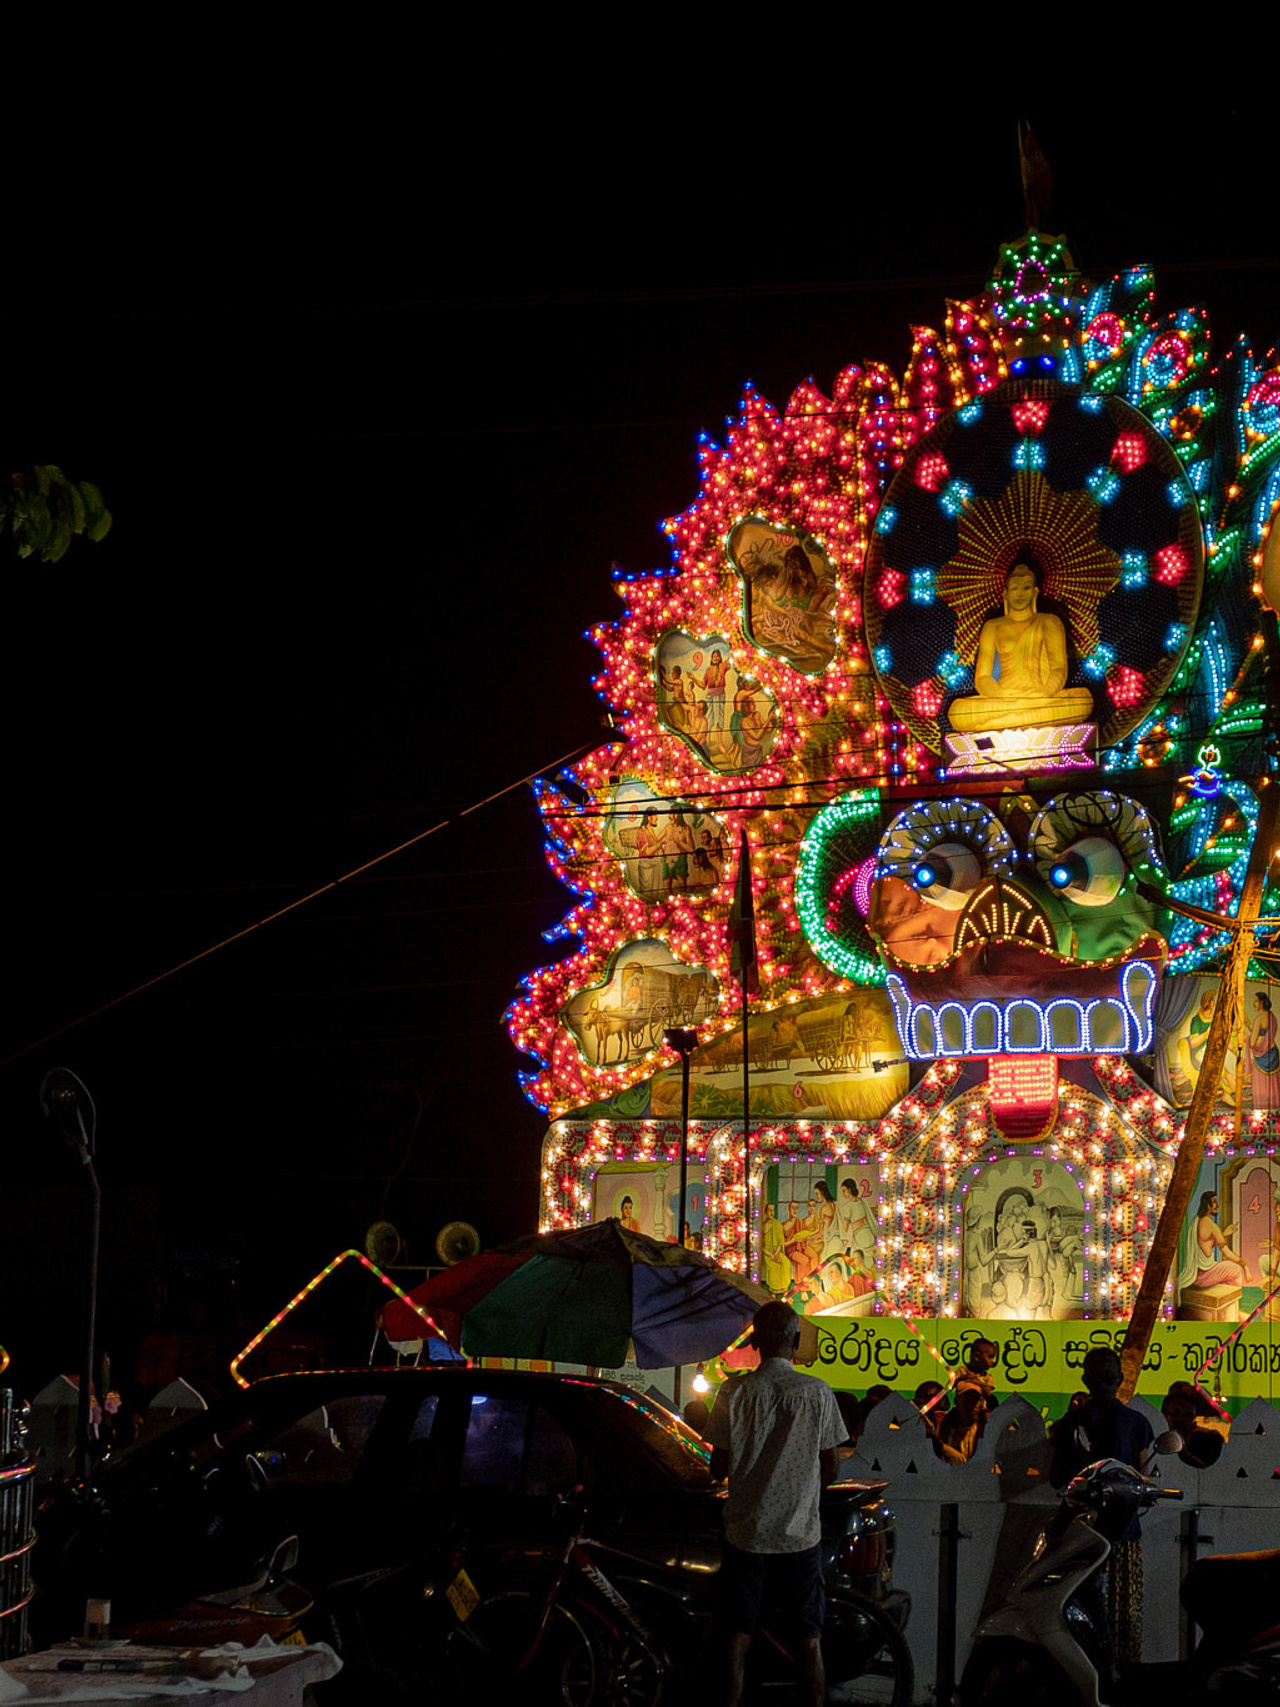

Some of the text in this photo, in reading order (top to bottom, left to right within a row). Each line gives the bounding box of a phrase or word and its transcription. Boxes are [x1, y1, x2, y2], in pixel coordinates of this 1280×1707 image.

[777, 531, 794, 547] 10
[693, 652, 703, 671] 9
[628, 804, 639, 822] 8
[794, 1081, 803, 1098] 6
[1032, 1169, 1043, 1188] 3
[860, 1180, 872, 1197] 2
[691, 1194, 699, 1212] 1
[1248, 1194, 1261, 1214] 4
[805, 1323, 919, 1381] රෝදය
